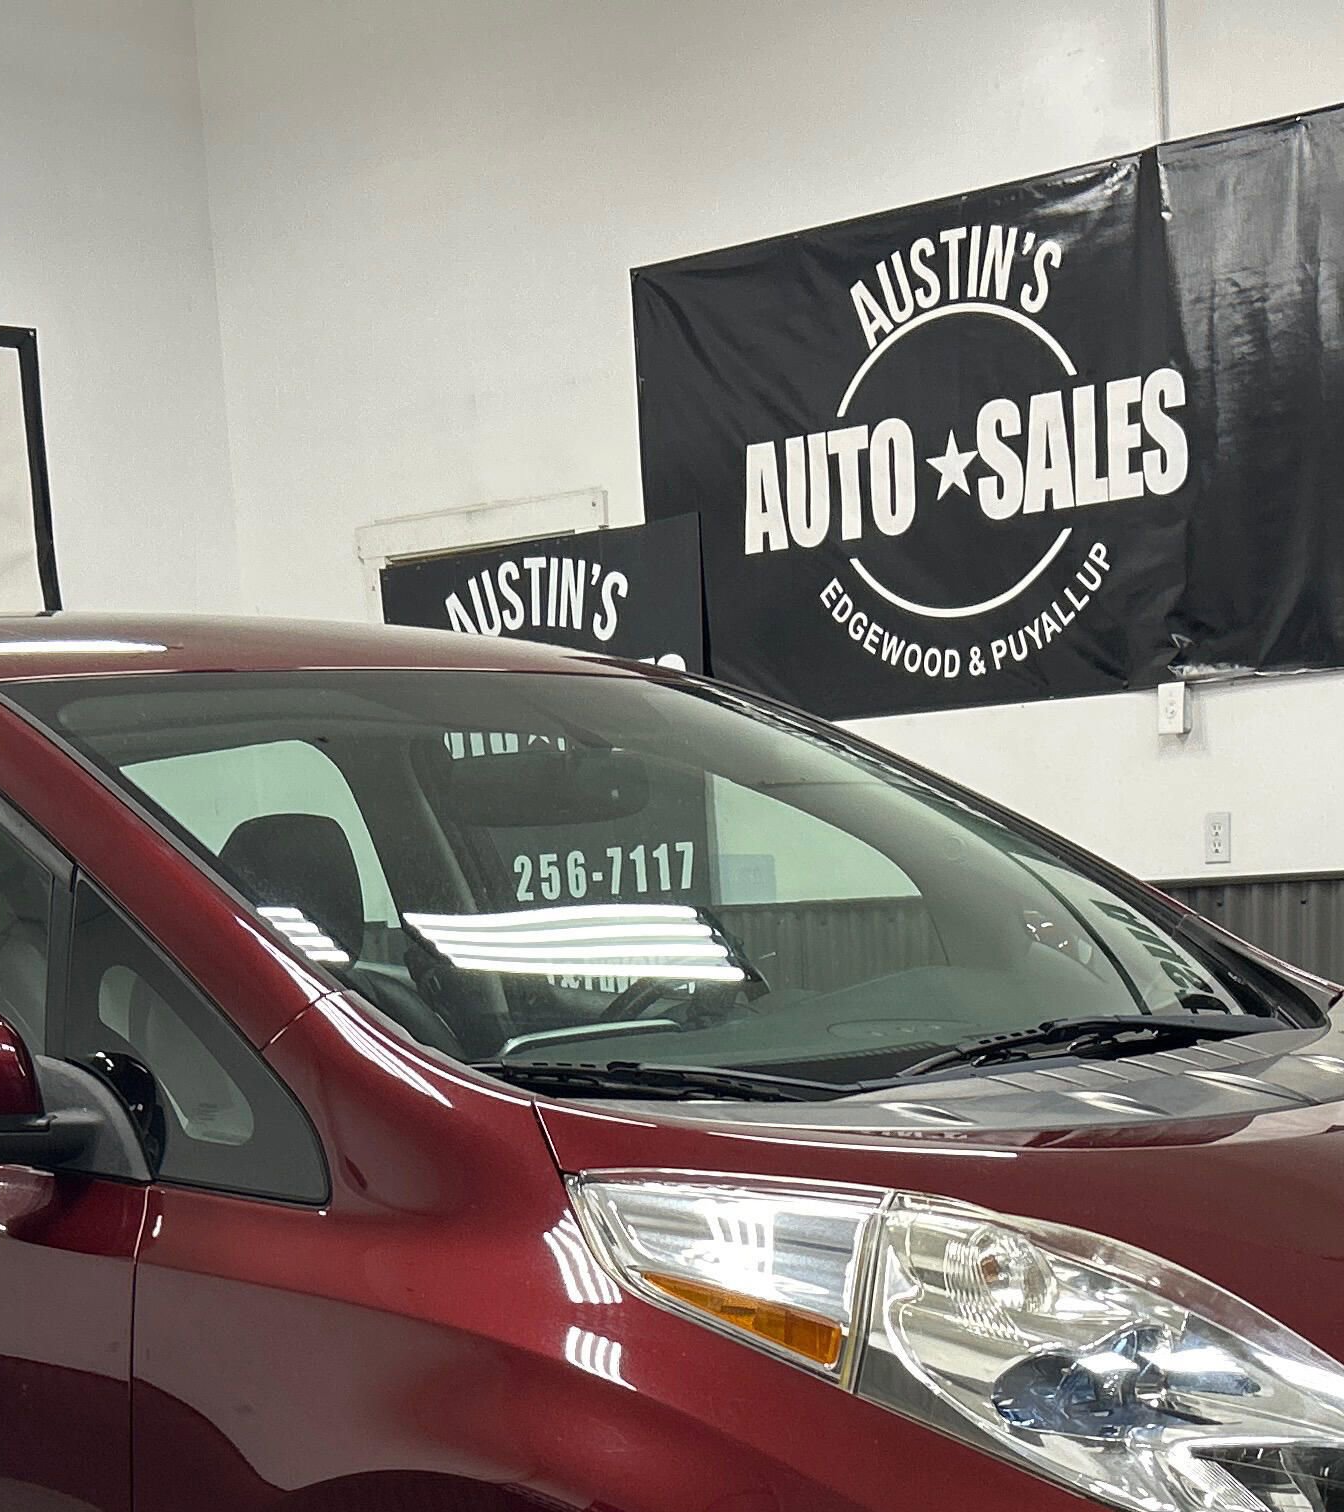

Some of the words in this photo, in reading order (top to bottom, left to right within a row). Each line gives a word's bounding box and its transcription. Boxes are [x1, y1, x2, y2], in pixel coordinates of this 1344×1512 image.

[850, 224, 1062, 350] AUSTIN'S
[745, 417, 916, 555] AUTO
[976, 368, 1188, 520] SALES
[444, 556, 629, 642] AUSTIN'S
[819, 577, 960, 679] EDGEWOOD
[969, 645, 987, 677] &
[992, 541, 1113, 664] PUYALLUP
[513, 841, 694, 902] 256-7117
